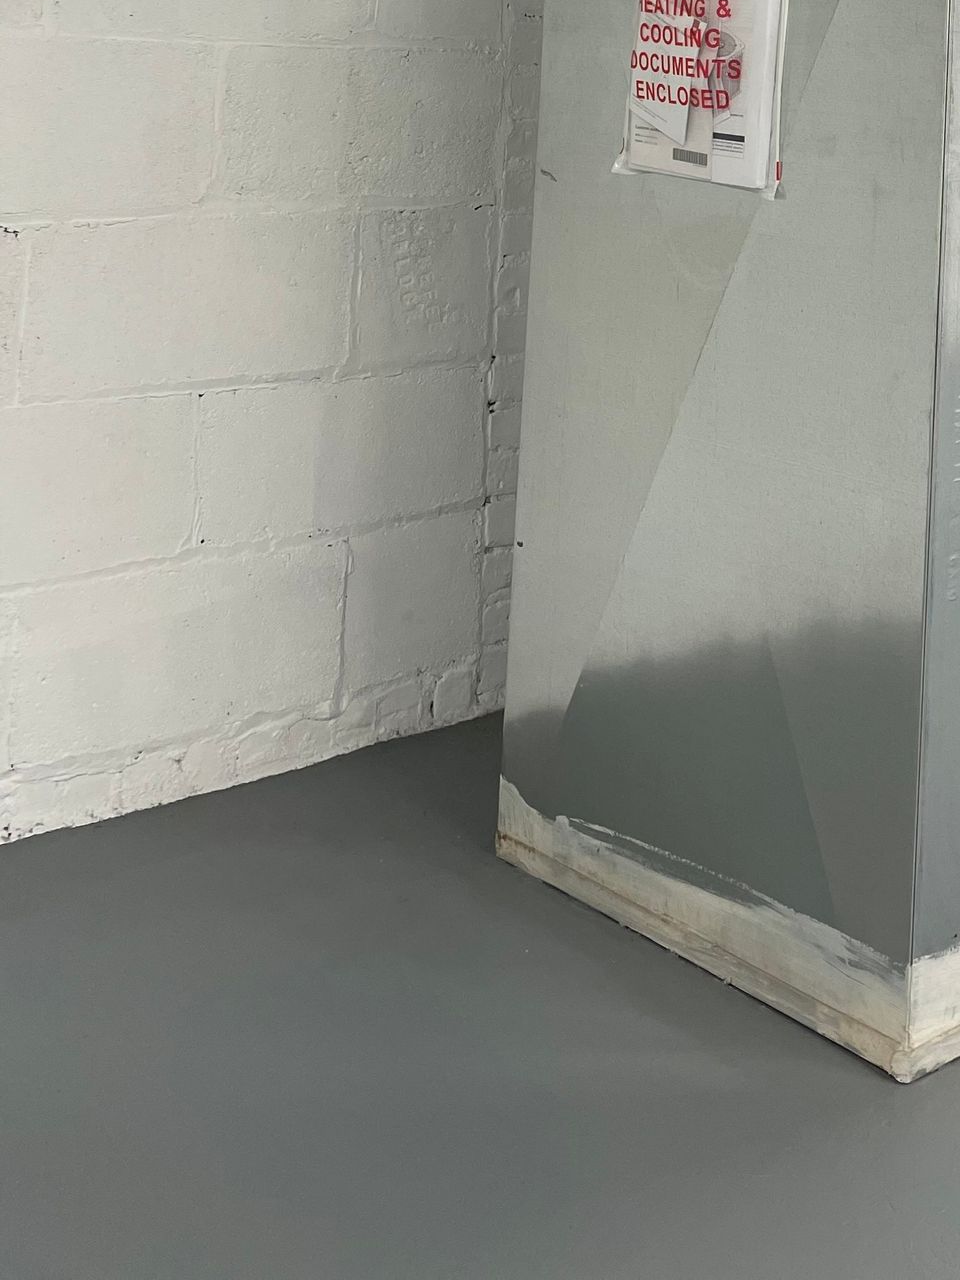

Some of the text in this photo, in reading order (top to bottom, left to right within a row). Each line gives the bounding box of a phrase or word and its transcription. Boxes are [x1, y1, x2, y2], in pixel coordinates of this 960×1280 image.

[639, 22, 721, 48] COOLING
[630, 49, 742, 80] DOCUMENTS
[635, 80, 730, 109] ENCLOSED
